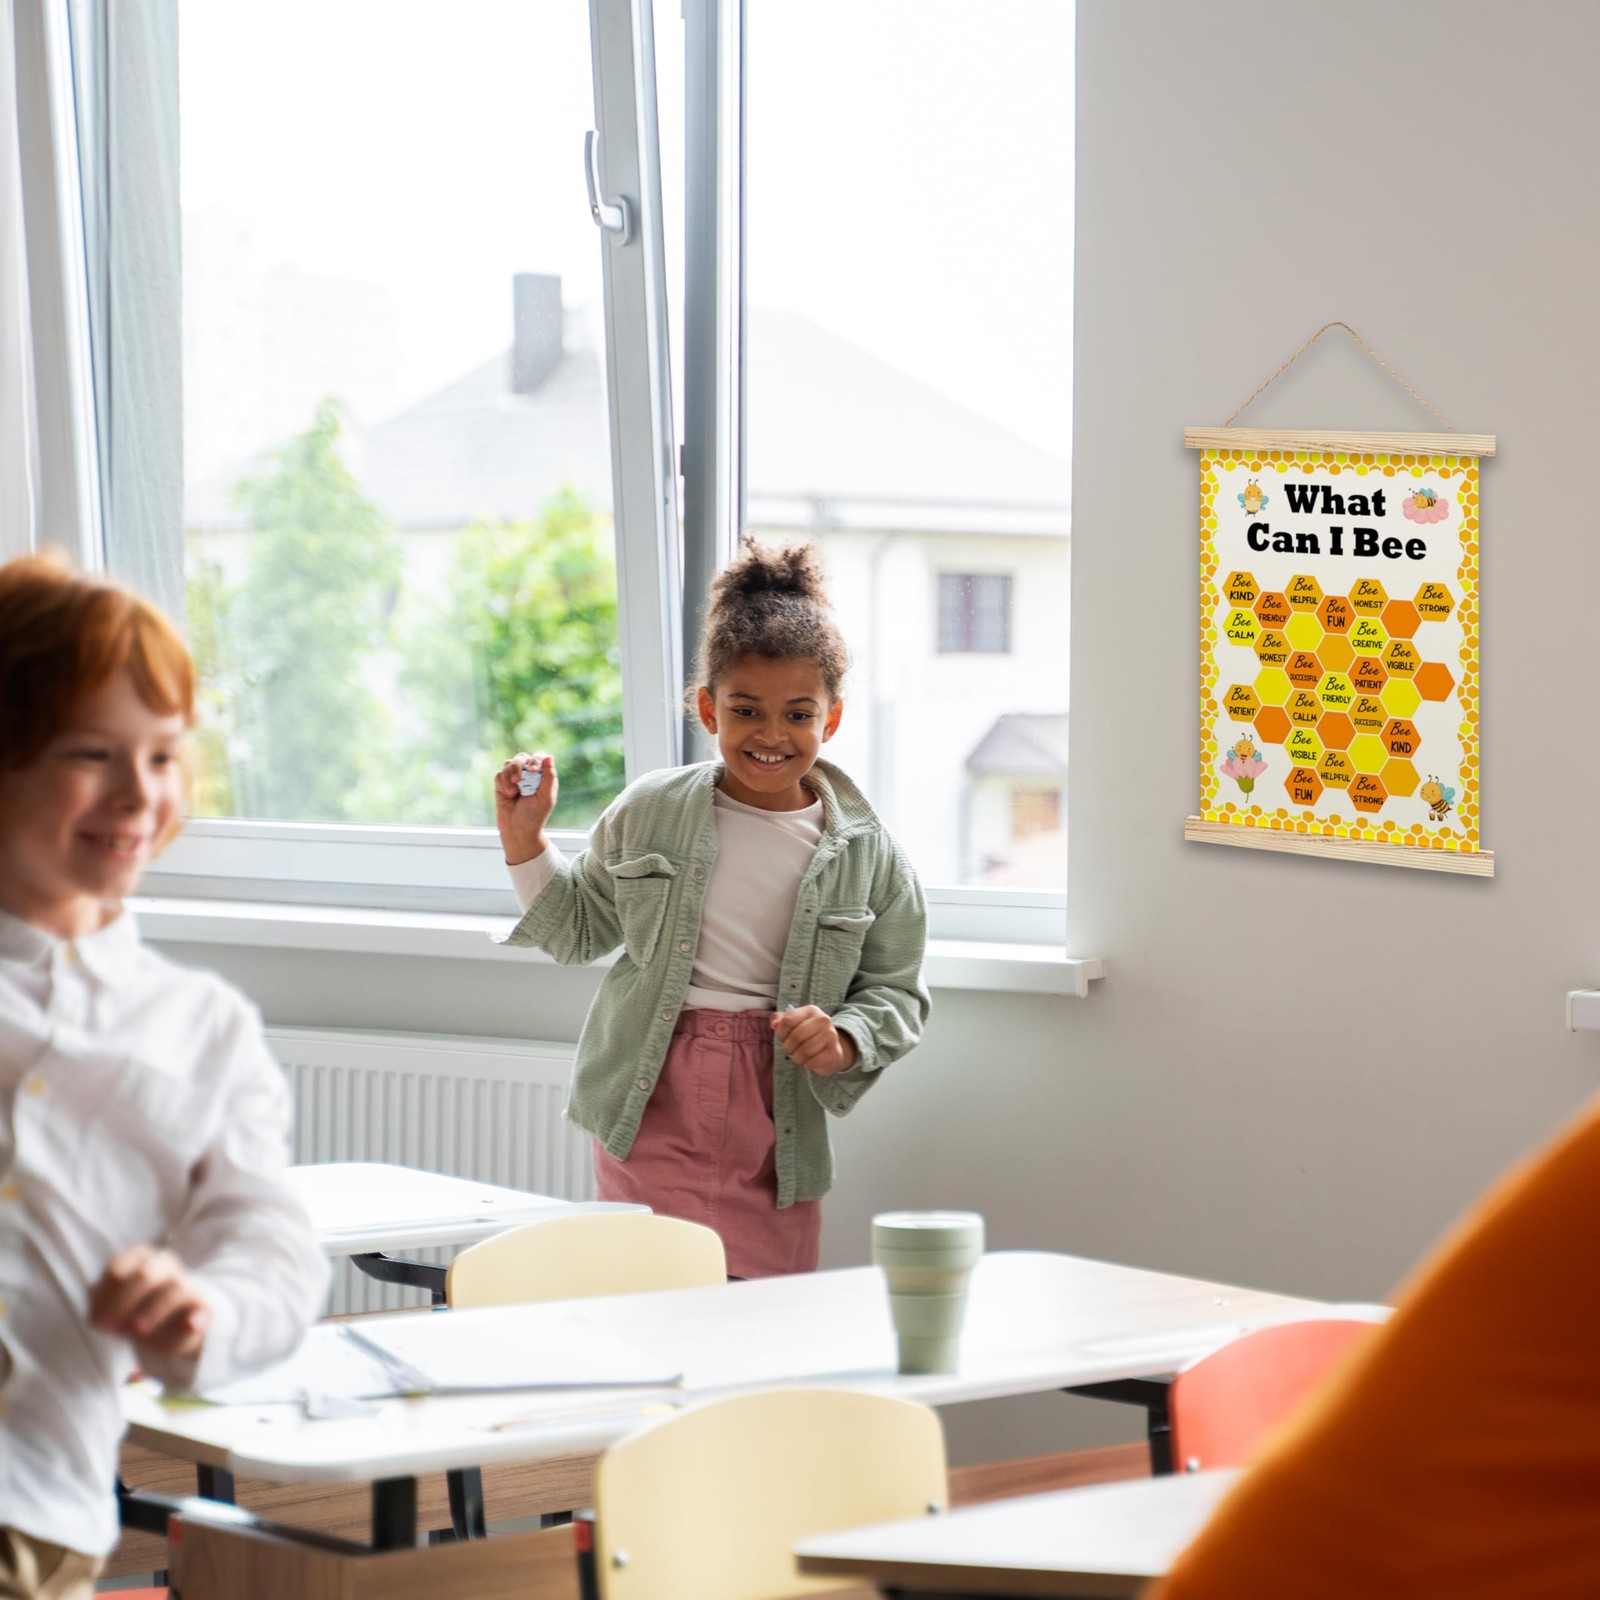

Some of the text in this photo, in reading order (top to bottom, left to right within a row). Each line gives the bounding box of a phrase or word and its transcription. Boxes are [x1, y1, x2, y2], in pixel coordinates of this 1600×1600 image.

[1284, 484, 1386, 517] What
[1247, 522, 1426, 560] Can I Bee
[1231, 573, 1252, 588] Bee
[1293, 577, 1314, 592] Bee
[1357, 580, 1379, 596] Bee
[1229, 590, 1255, 602] KIND
[1422, 584, 1444, 600] Bee
[1262, 594, 1282, 609] Bee
[1289, 595, 1319, 605] HELPFUL
[1325, 599, 1346, 614] Bee
[1353, 599, 1384, 609] HONEST
[1418, 603, 1451, 614] STRONG
[1231, 612, 1252, 627] Bee
[1258, 612, 1287, 623] FRIENDLY
[1326, 614, 1346, 628] FUN
[1227, 629, 1255, 640] CALM
[1356, 621, 1378, 636] Bee
[1262, 633, 1282, 648] Bee
[1351, 639, 1383, 650] CREATIVE
[1259, 652, 1288, 663] HONEST
[1390, 643, 1412, 658] Bee
[1293, 654, 1314, 669] Bee
[1358, 661, 1380, 676] Bee
[1289, 673, 1319, 683] SUCCESSFUL
[1325, 676, 1346, 691] Bee
[1354, 678, 1383, 690] PATIENT
[1230, 686, 1251, 701] Bee
[1294, 693, 1316, 708] Bee
[1322, 693, 1352, 704] FRIENDLY
[1228, 705, 1256, 717] PATIENT
[1357, 698, 1378, 713] Bee
[1353, 717, 1384, 728] SUCCESSFUL
[1389, 721, 1411, 737] Bee
[1291, 730, 1313, 745] Bee
[1390, 740, 1413, 754] KIND
[1290, 749, 1317, 761] VISIBLE
[1324, 752, 1345, 768] Bee
[1293, 769, 1313, 784] Bee
[1320, 771, 1351, 783] HELPFUL
[1356, 776, 1377, 791] Bee
[1294, 787, 1313, 801] FUN
[1352, 794, 1384, 806] STRONG
